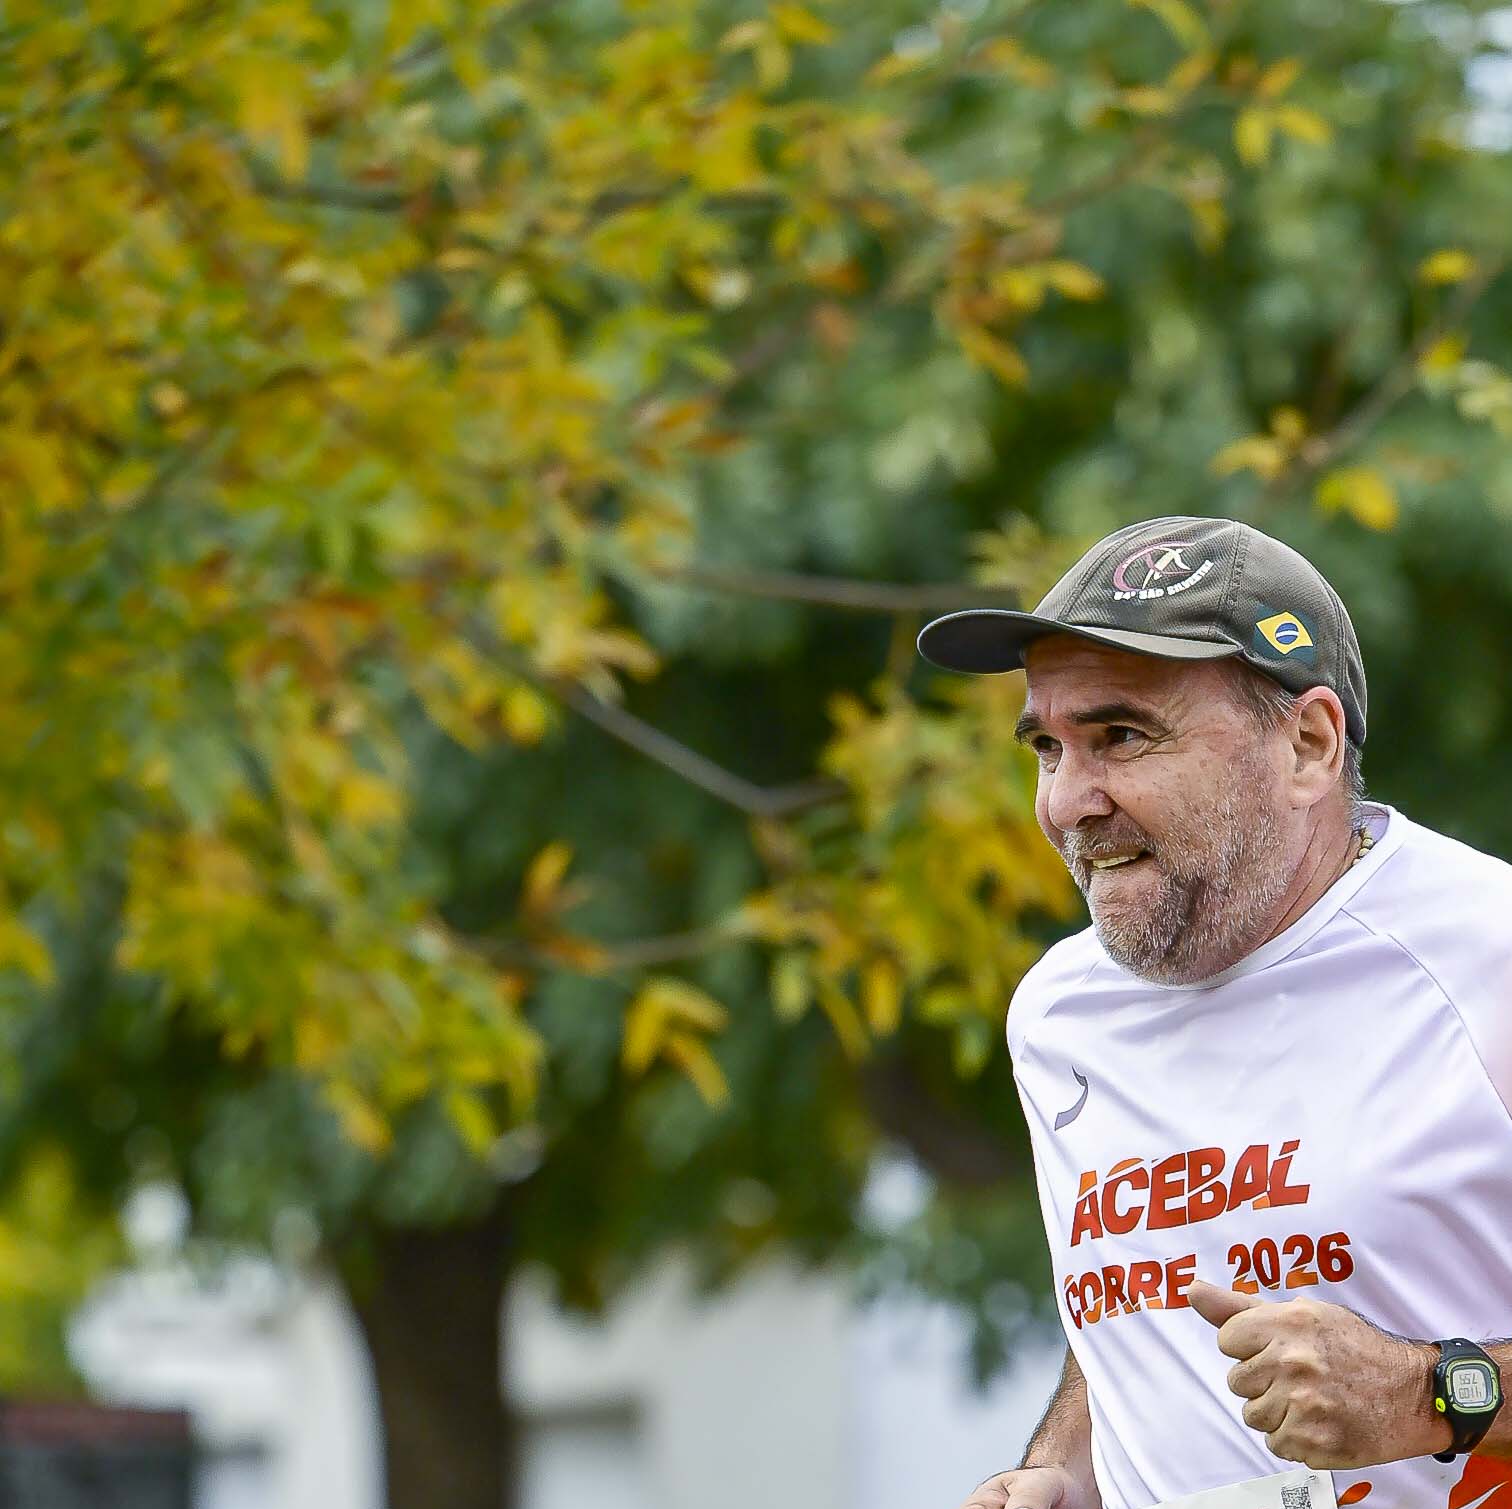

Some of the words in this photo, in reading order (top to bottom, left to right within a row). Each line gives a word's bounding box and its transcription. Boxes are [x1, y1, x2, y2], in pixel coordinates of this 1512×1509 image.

[1070, 1139, 1310, 1247] ACEBAL
[1064, 1254, 1196, 1329] CORRE
[1227, 1231, 1354, 1294] 2026
